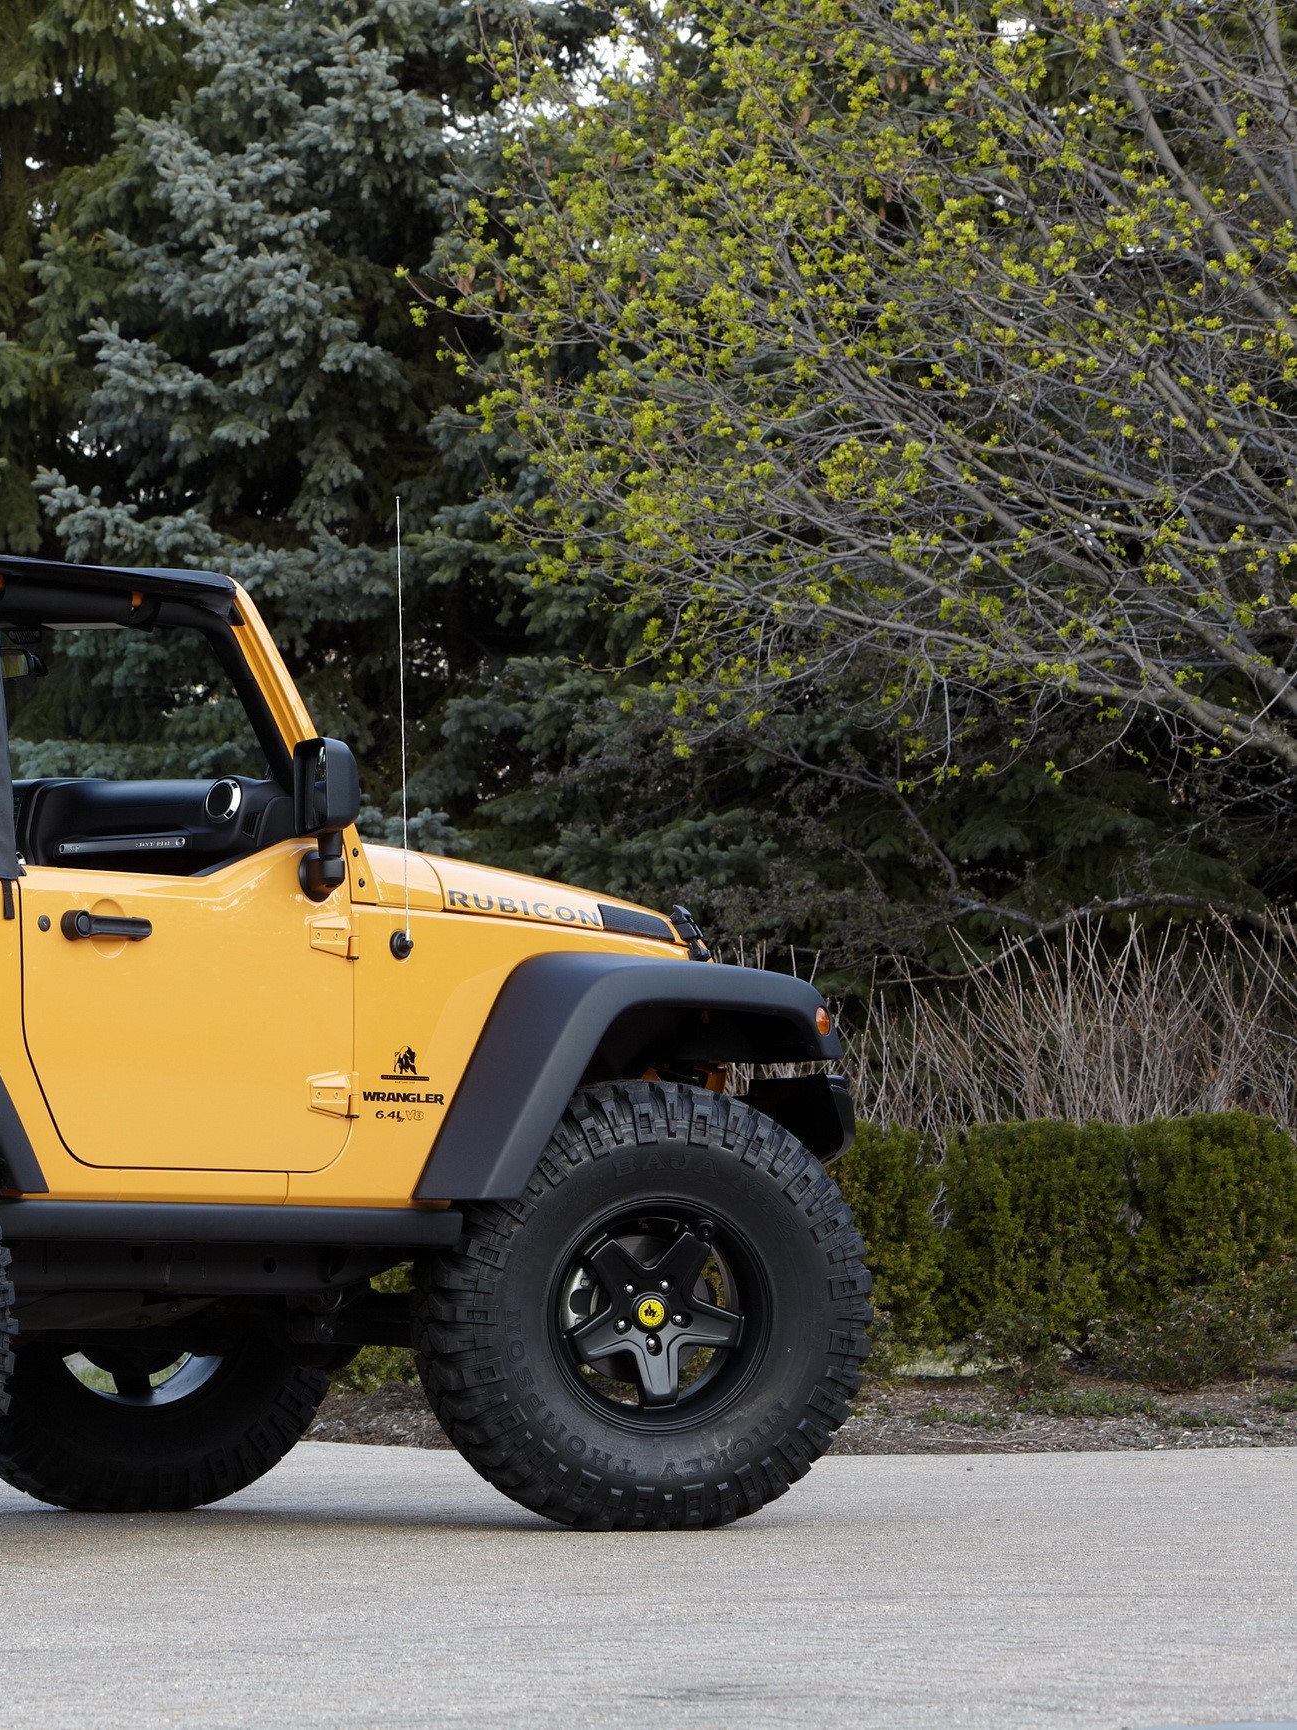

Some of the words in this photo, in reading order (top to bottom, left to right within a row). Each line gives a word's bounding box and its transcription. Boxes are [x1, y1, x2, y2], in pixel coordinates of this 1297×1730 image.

[448, 889, 601, 927] RUBICON
[362, 1091, 444, 1105] WRANGLER
[405, 1109, 424, 1121] V8
